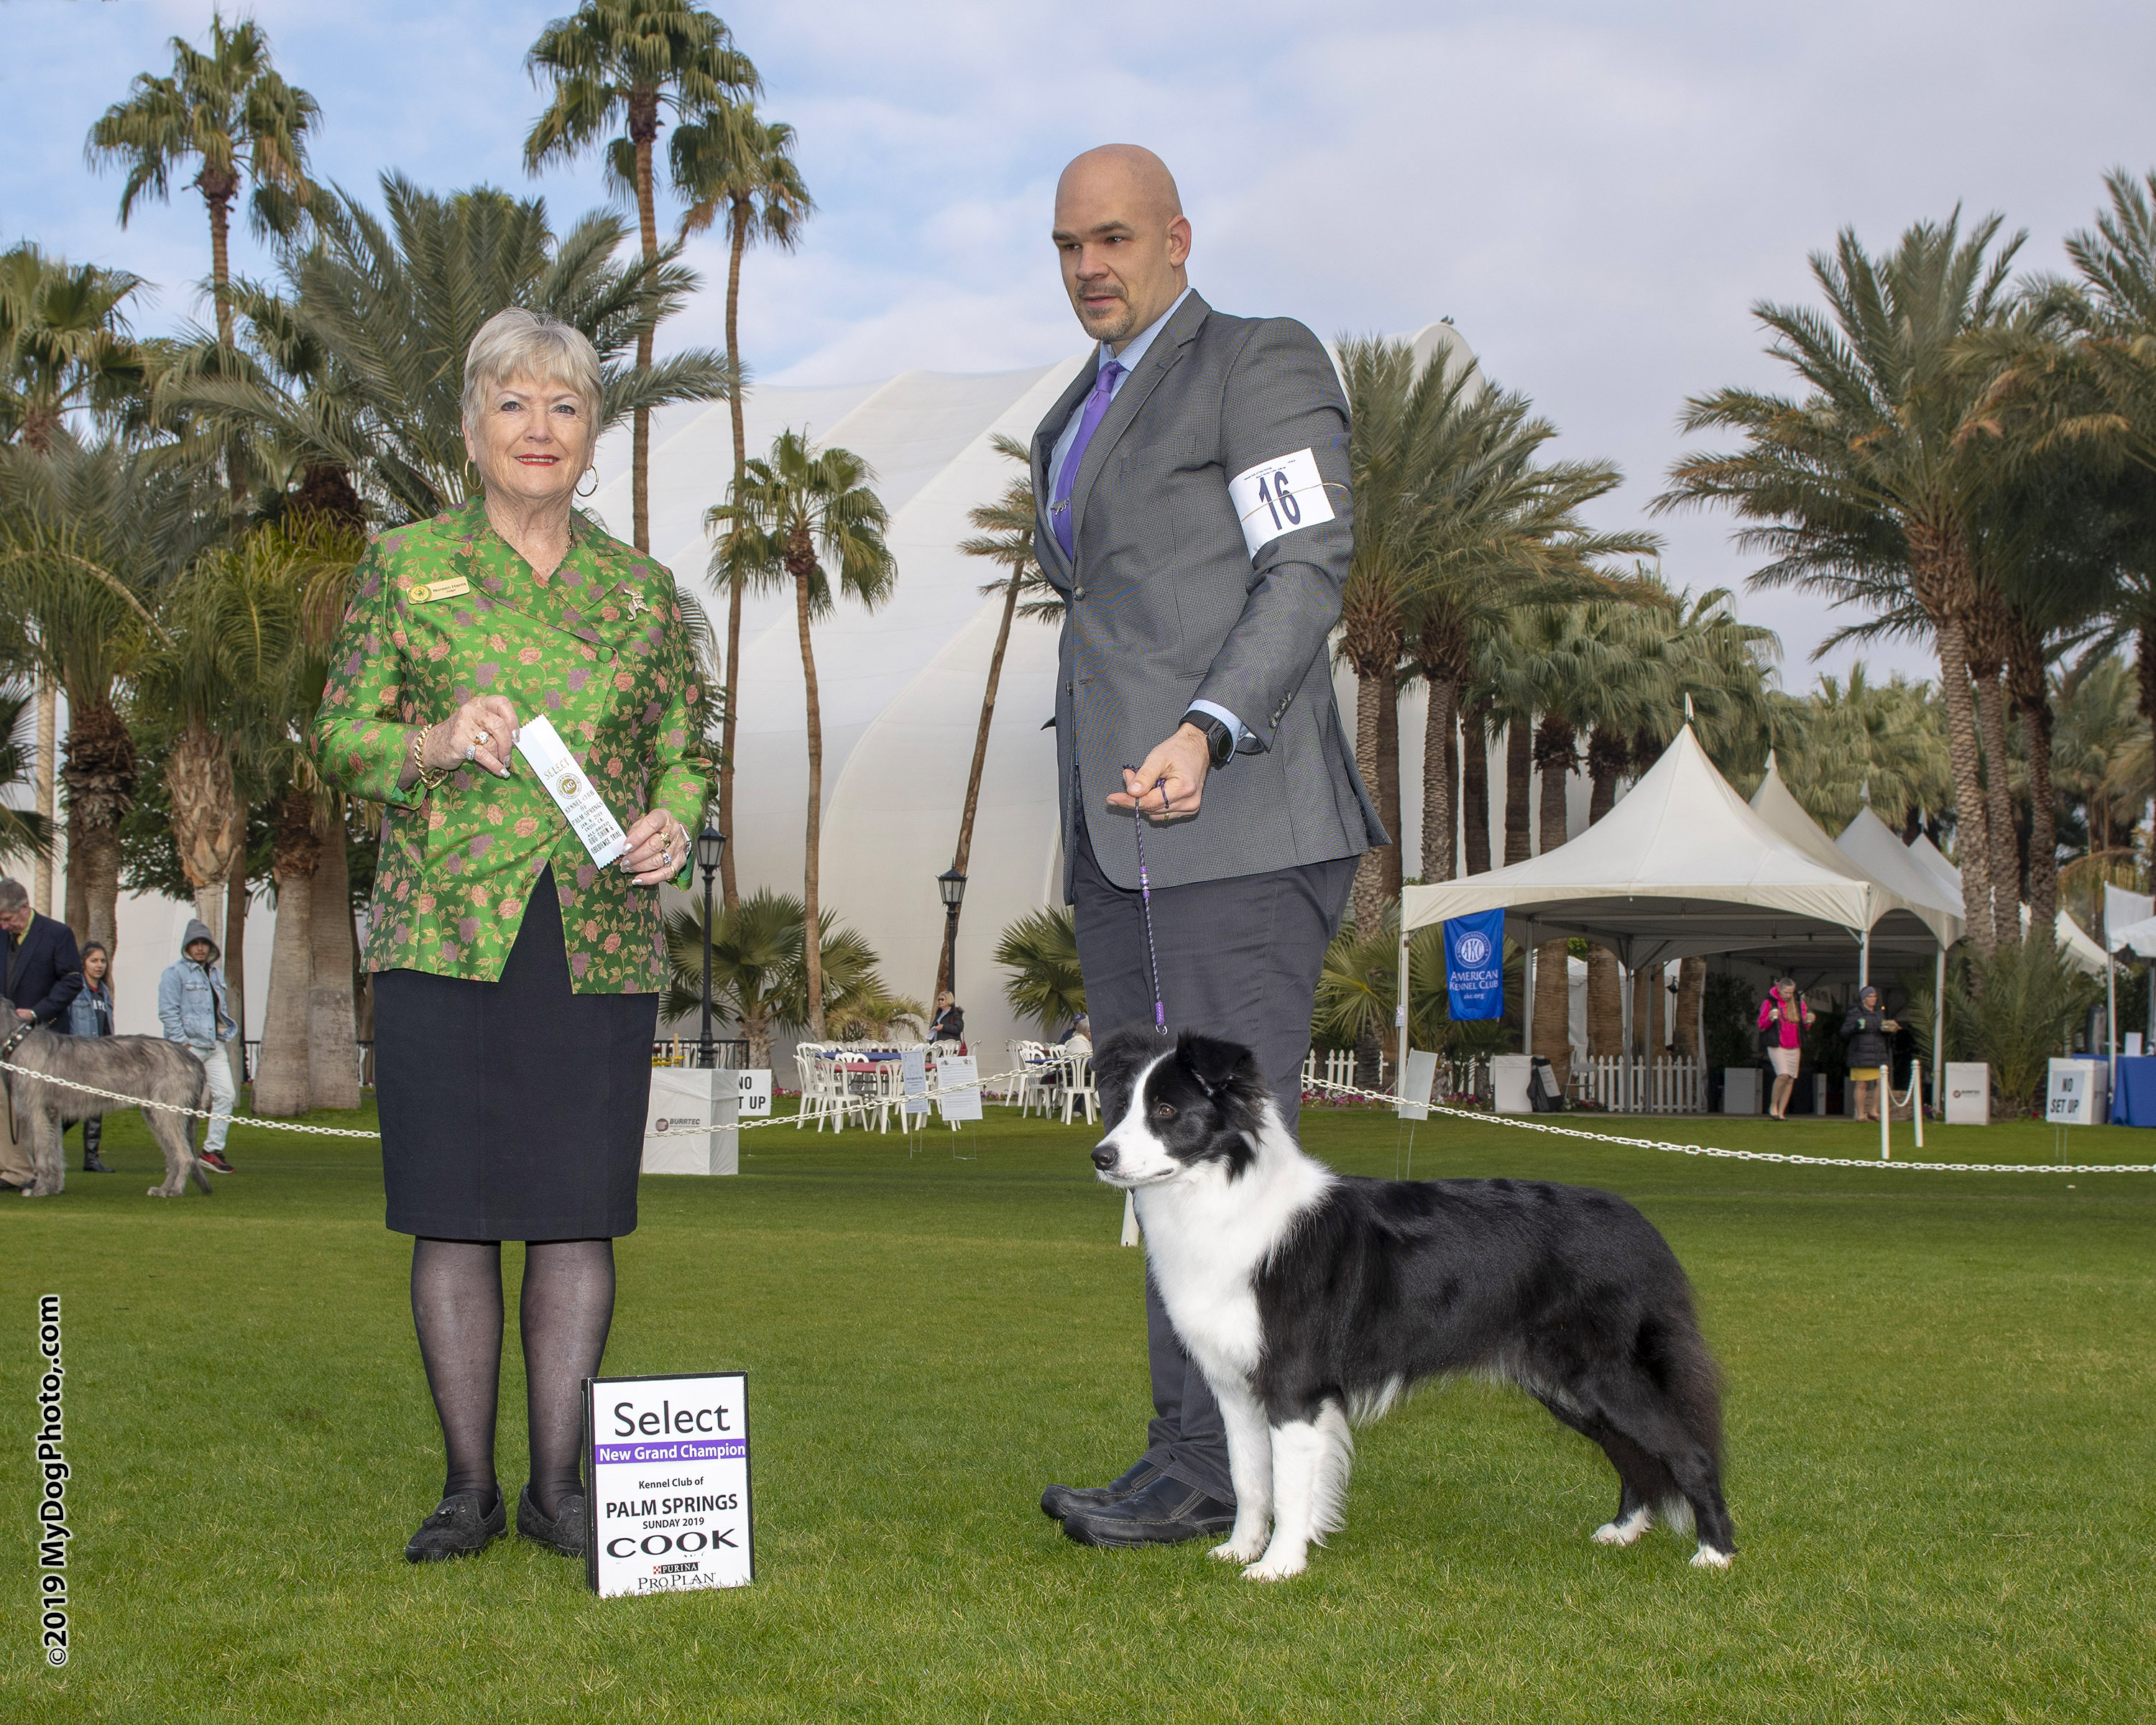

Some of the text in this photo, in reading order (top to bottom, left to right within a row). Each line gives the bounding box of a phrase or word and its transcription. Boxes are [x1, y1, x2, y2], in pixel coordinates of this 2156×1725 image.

[1259, 472, 1300, 530] 16
[544, 758, 569, 780] SELECT
[563, 781, 575, 791] AKC
[565, 799, 582, 814] KENNEL
[582, 791, 594, 801] CLUB
[571, 801, 604, 826] PALM SPRINGS
[589, 835, 598, 845] DOG
[598, 828, 609, 839] SHOW
[591, 831, 622, 855] OBEDIENCE TRIAL
[1463, 939, 1483, 960] AKC
[1451, 970, 1498, 981] AMERICAN
[1450, 982, 1477, 990] KENNEL
[2062, 1078, 2073, 1092] NO
[750, 1097, 765, 1109] UP
[2050, 1099, 2079, 1113] SET UP
[614, 1400, 730, 1437] Select
[600, 1443, 745, 1462] New Grand Champion
[639, 1477, 704, 1489] Kennel Club of
[606, 1494, 738, 1519] PALM SPRINGS
[642, 1517, 704, 1529] SUNDAY 2019
[607, 1529, 739, 1558] COOK
[662, 1563, 698, 1573] PURINA
